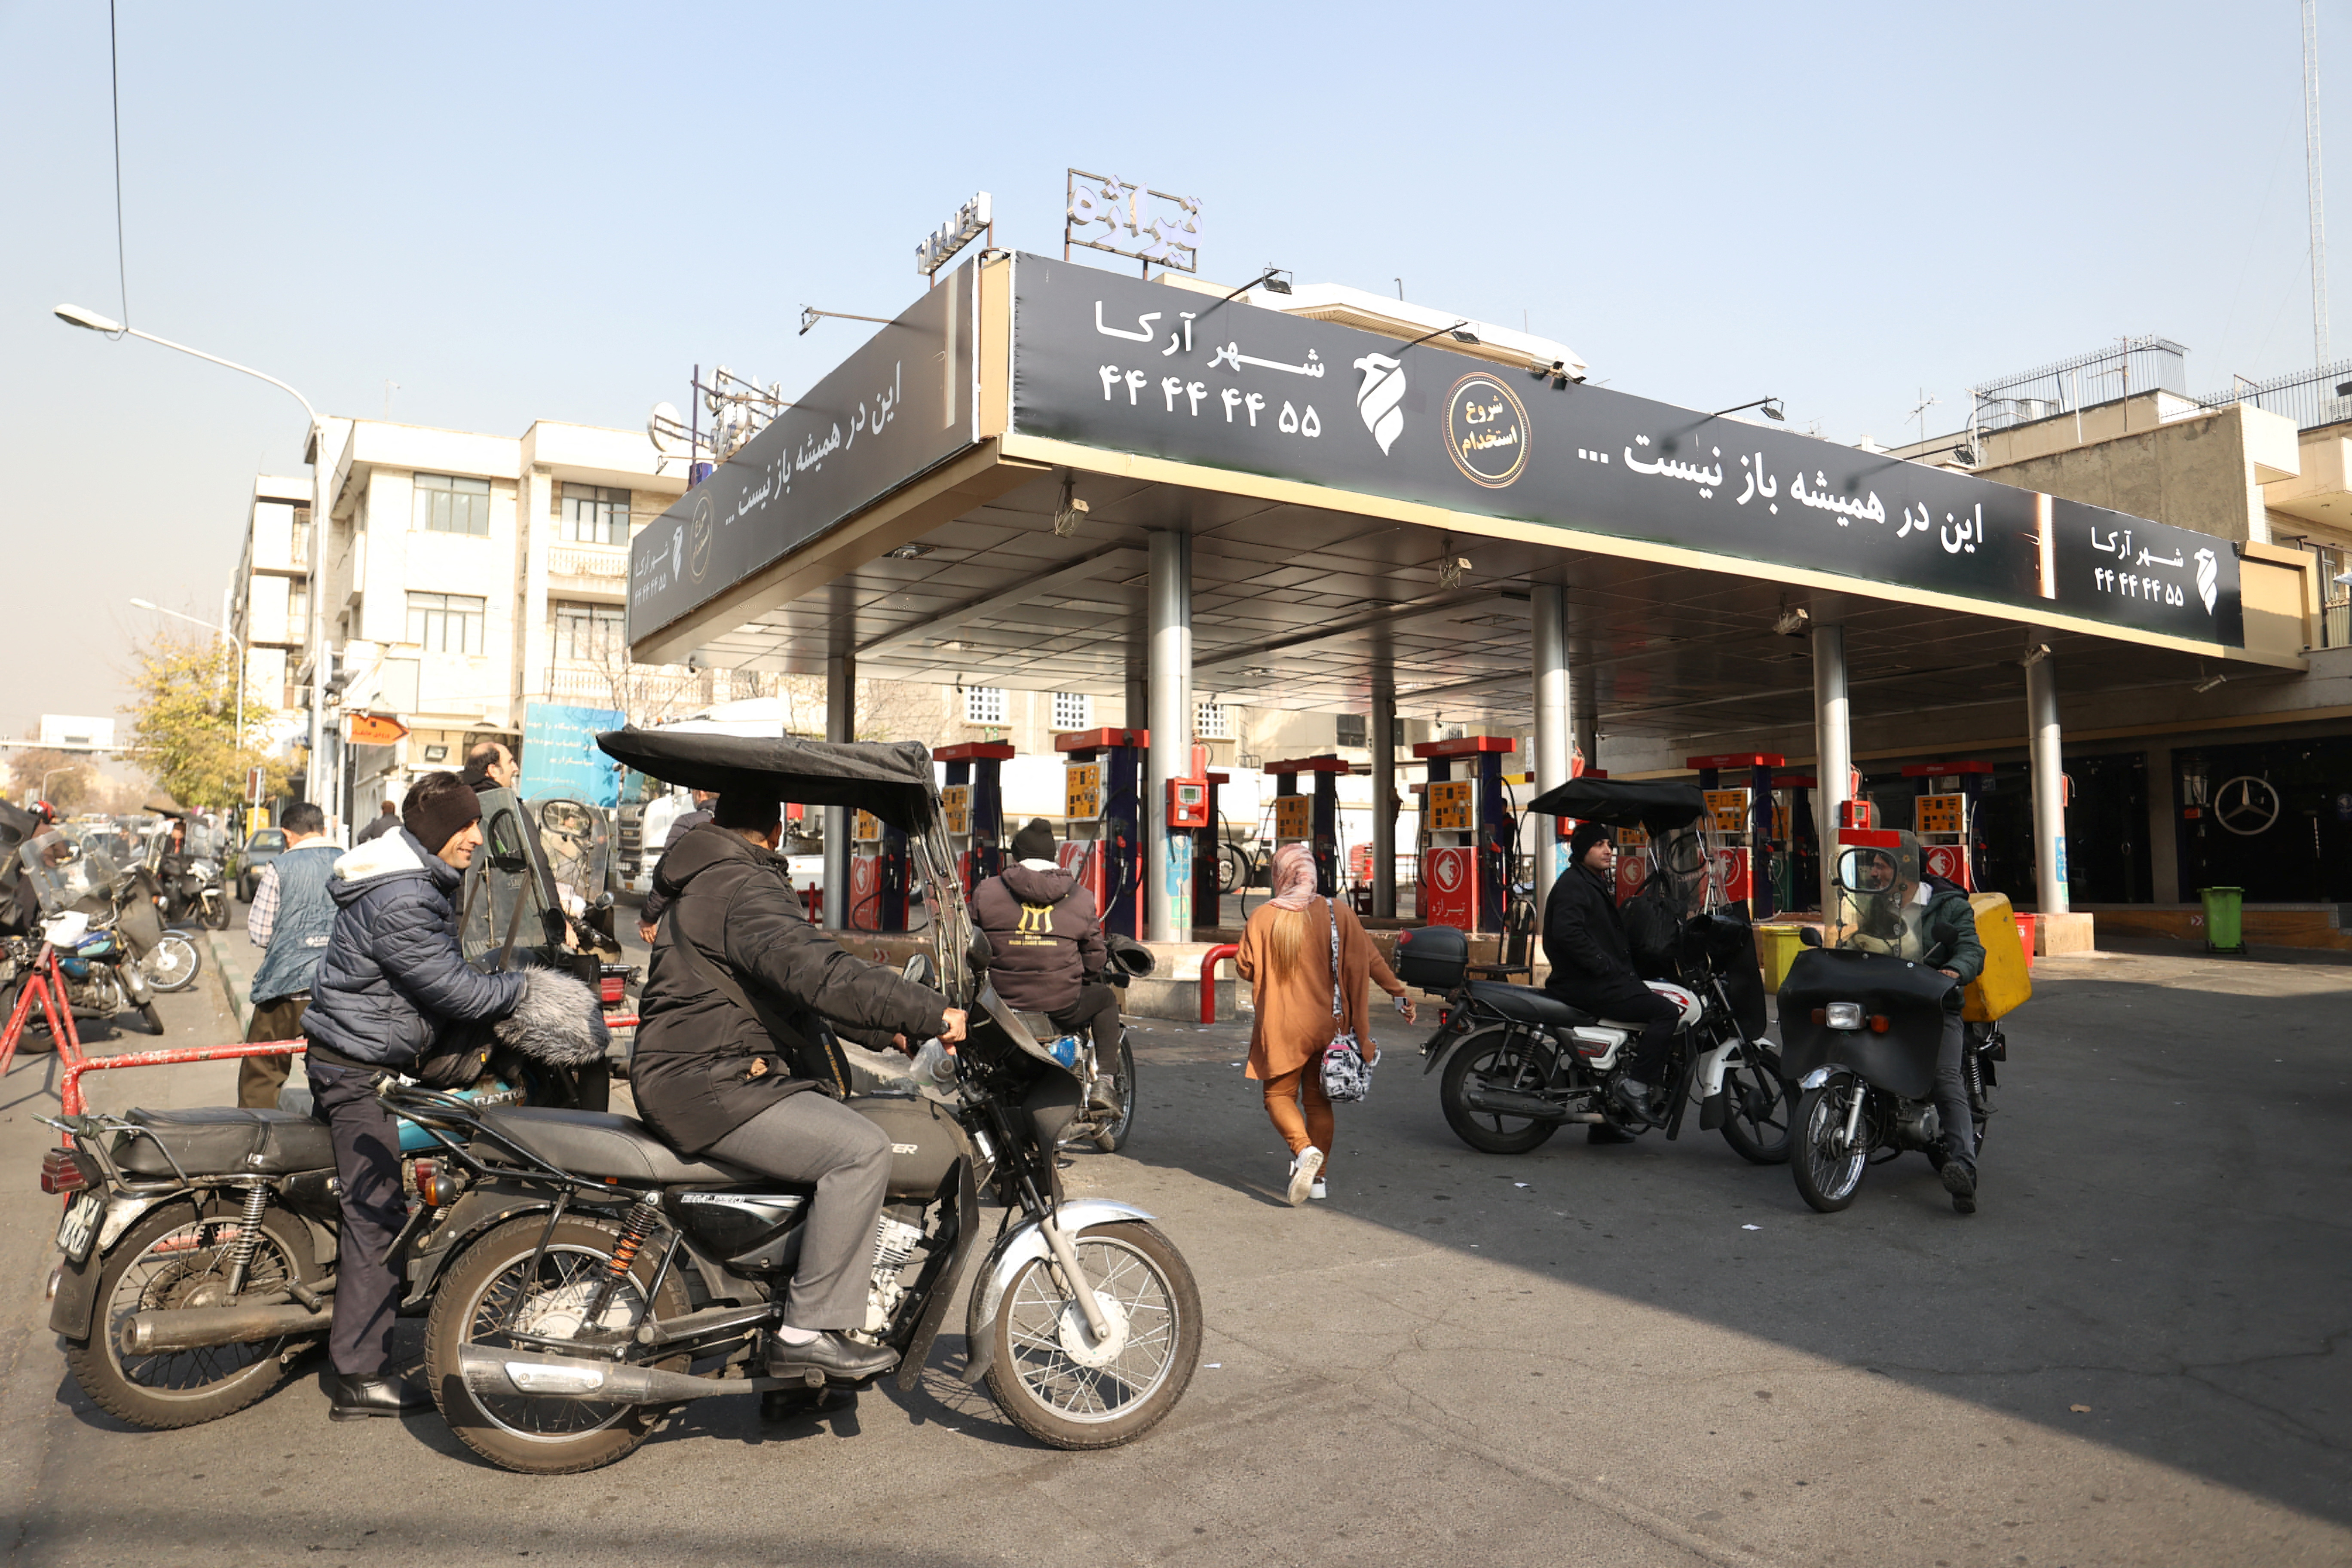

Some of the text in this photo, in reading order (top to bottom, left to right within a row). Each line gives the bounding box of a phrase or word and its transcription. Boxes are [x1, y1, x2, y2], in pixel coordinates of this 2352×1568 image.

[916, 190, 992, 276] TIRAJEH
[1068, 175, 1204, 268] تیراژه
[1095, 301, 1325, 378] شهر آرکا
[872, 360, 901, 435] این
[1099, 365, 1321, 438] ۴۴ ۴۴ ۴۴ ۵۵
[1465, 395, 1503, 424] شروع
[796, 423, 841, 472] همیشه
[845, 402, 866, 450] در
[1462, 424, 1518, 458] استخدام
[738, 465, 771, 516] نیست
[774, 448, 791, 500] باز
[1624, 434, 1723, 499] نیست
[1736, 451, 1778, 515] باز
[1790, 470, 1886, 527] همیشه
[1896, 501, 1929, 538] در
[1941, 503, 1982, 554] این
[2091, 526, 2184, 568] شهر آرکا
[635, 541, 669, 577] شهر آرکا
[658, 572, 666, 592] ۵۵
[2095, 567, 2184, 606] ۴۴ ۴۴ ۴۴ ۵۵
[1432, 897, 1466, 917] تیراژه
